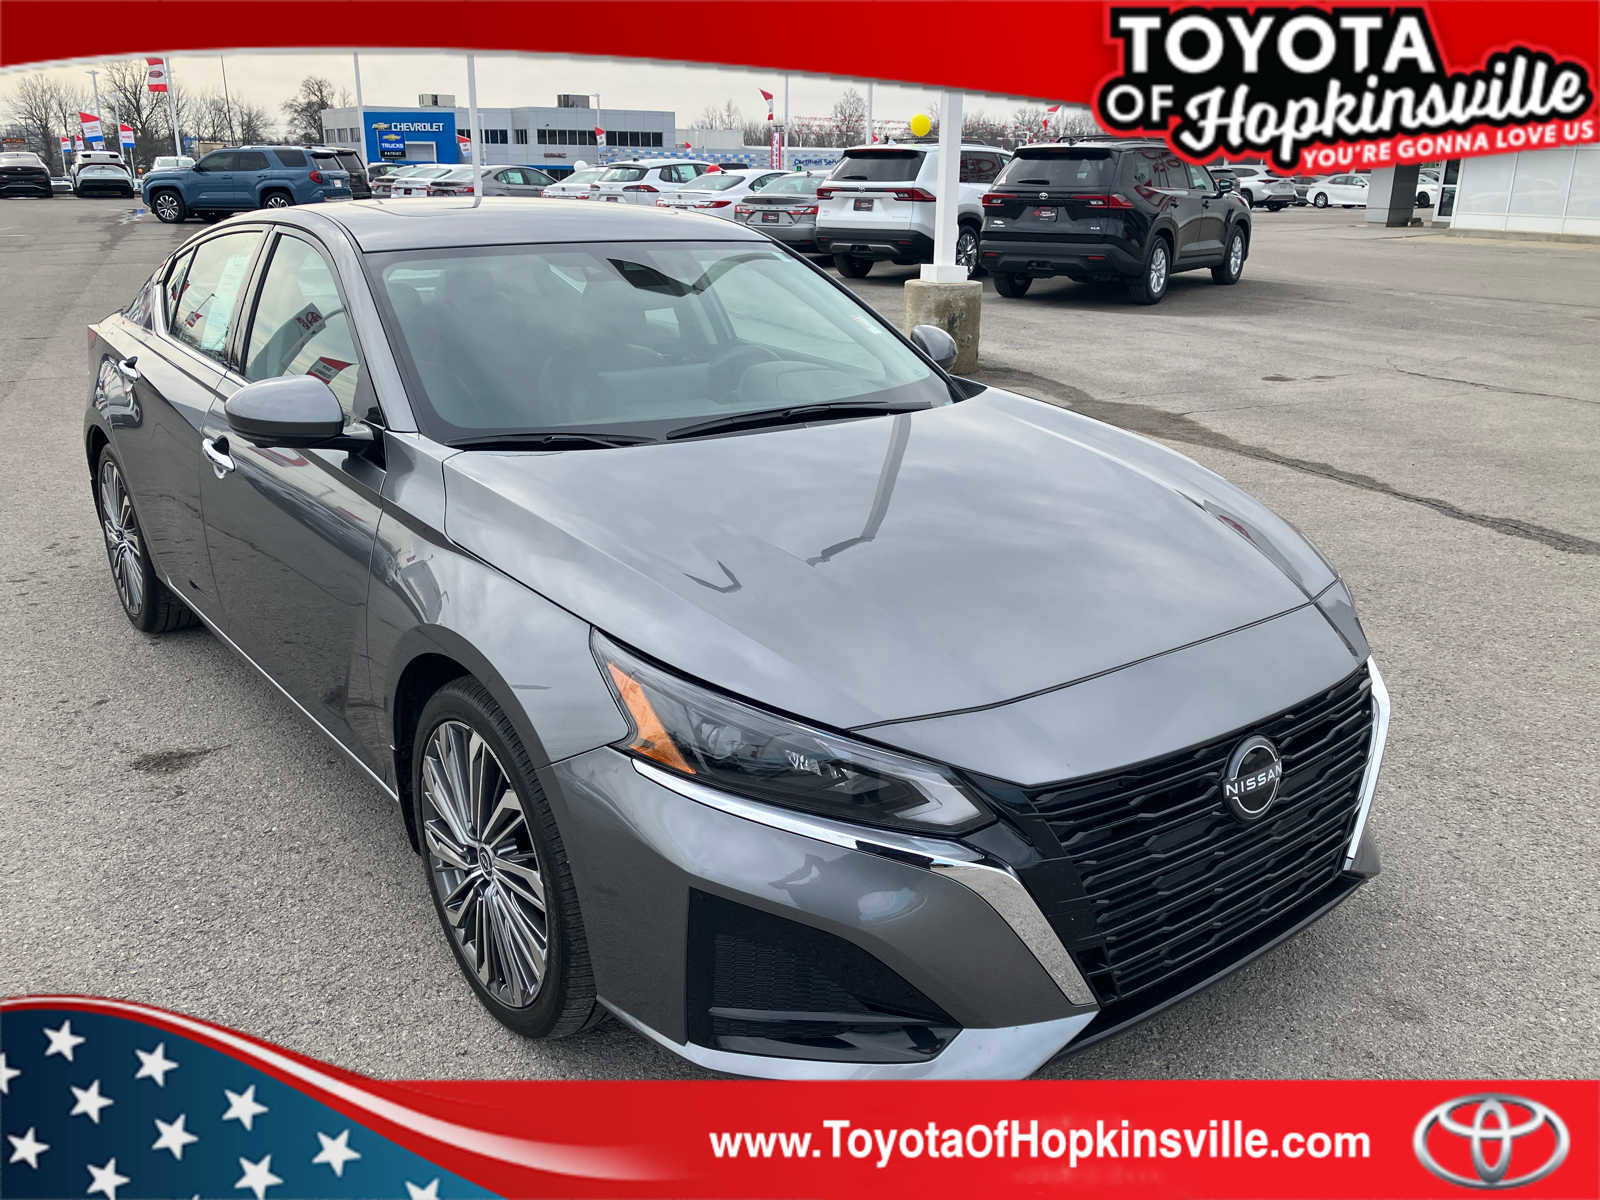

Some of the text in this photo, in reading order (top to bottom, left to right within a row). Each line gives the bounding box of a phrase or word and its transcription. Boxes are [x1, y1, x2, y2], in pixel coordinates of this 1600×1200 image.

[391, 122, 445, 132] CHEVROLET
[823, 158, 840, 166] Serv
[1225, 763, 1282, 797] NISSAN
